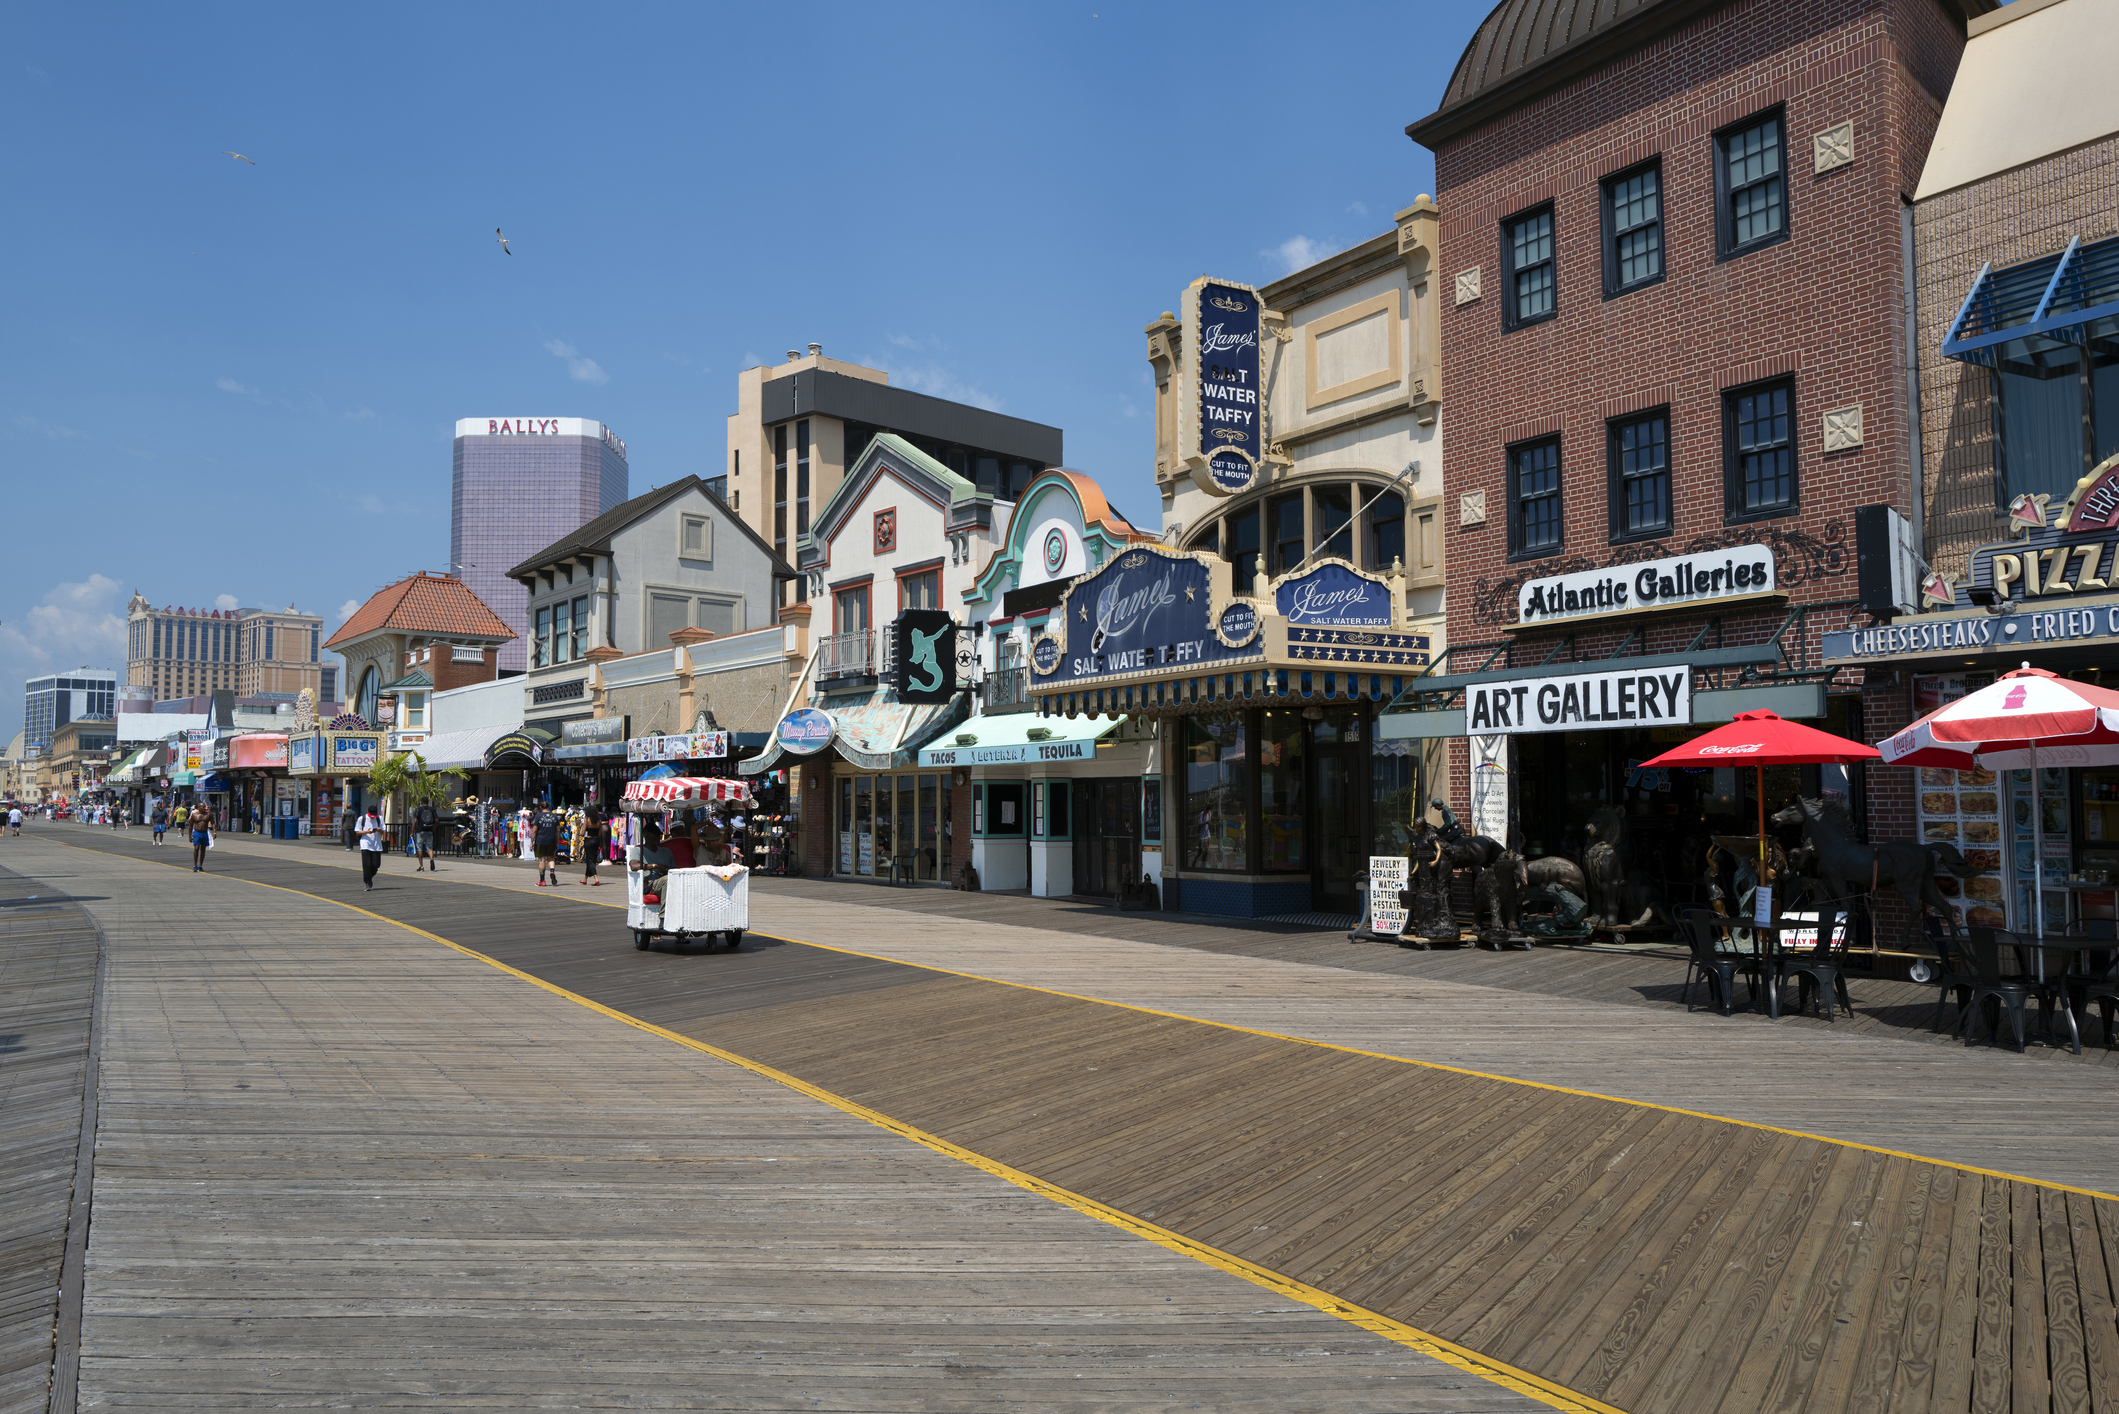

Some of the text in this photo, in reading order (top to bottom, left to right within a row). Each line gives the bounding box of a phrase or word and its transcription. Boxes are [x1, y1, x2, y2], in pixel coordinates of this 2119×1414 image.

[1211, 364, 1248, 384] SALT
[1203, 382, 1256, 404] WATER
[1206, 405, 1252, 425] TAFFY
[489, 419, 559, 434] BALLYS
[1225, 471, 1249, 480] MOUTH
[1524, 559, 1768, 617] Atlantic Galleries
[164, 604, 241, 620] CAESARS
[1223, 611, 1254, 623] CUT TO FIT
[1222, 621, 1255, 633] THE MOUTH
[1310, 617, 1389, 625] SALT WATER TAFFY
[1852, 619, 1990, 654] CHEESESTEAKS
[2031, 610, 2095, 640] FRIED
[1073, 639, 1204, 676] SALT WATER TAFFY
[1920, 677, 1990, 691] Three Brothers
[1471, 672, 1684, 730] ART GALLERY
[1345, 731, 1360, 742] 1519
[1662, 729, 1690, 738] THAN
[336, 739, 377, 752] BIG G'S
[930, 752, 956, 764] TACOS
[1038, 743, 1083, 760] TEQUILA
[336, 756, 376, 764] TATTOOS
[1629, 759, 1670, 792] 75%
[1372, 859, 1400, 869] JEWELRY
[1371, 870, 1400, 879] REPAIRES
[1378, 880, 1399, 890] WATCH
[1372, 890, 1398, 900] BATTERI
[1377, 900, 1400, 910] ESTATE
[1378, 911, 1407, 921] JEWELRY
